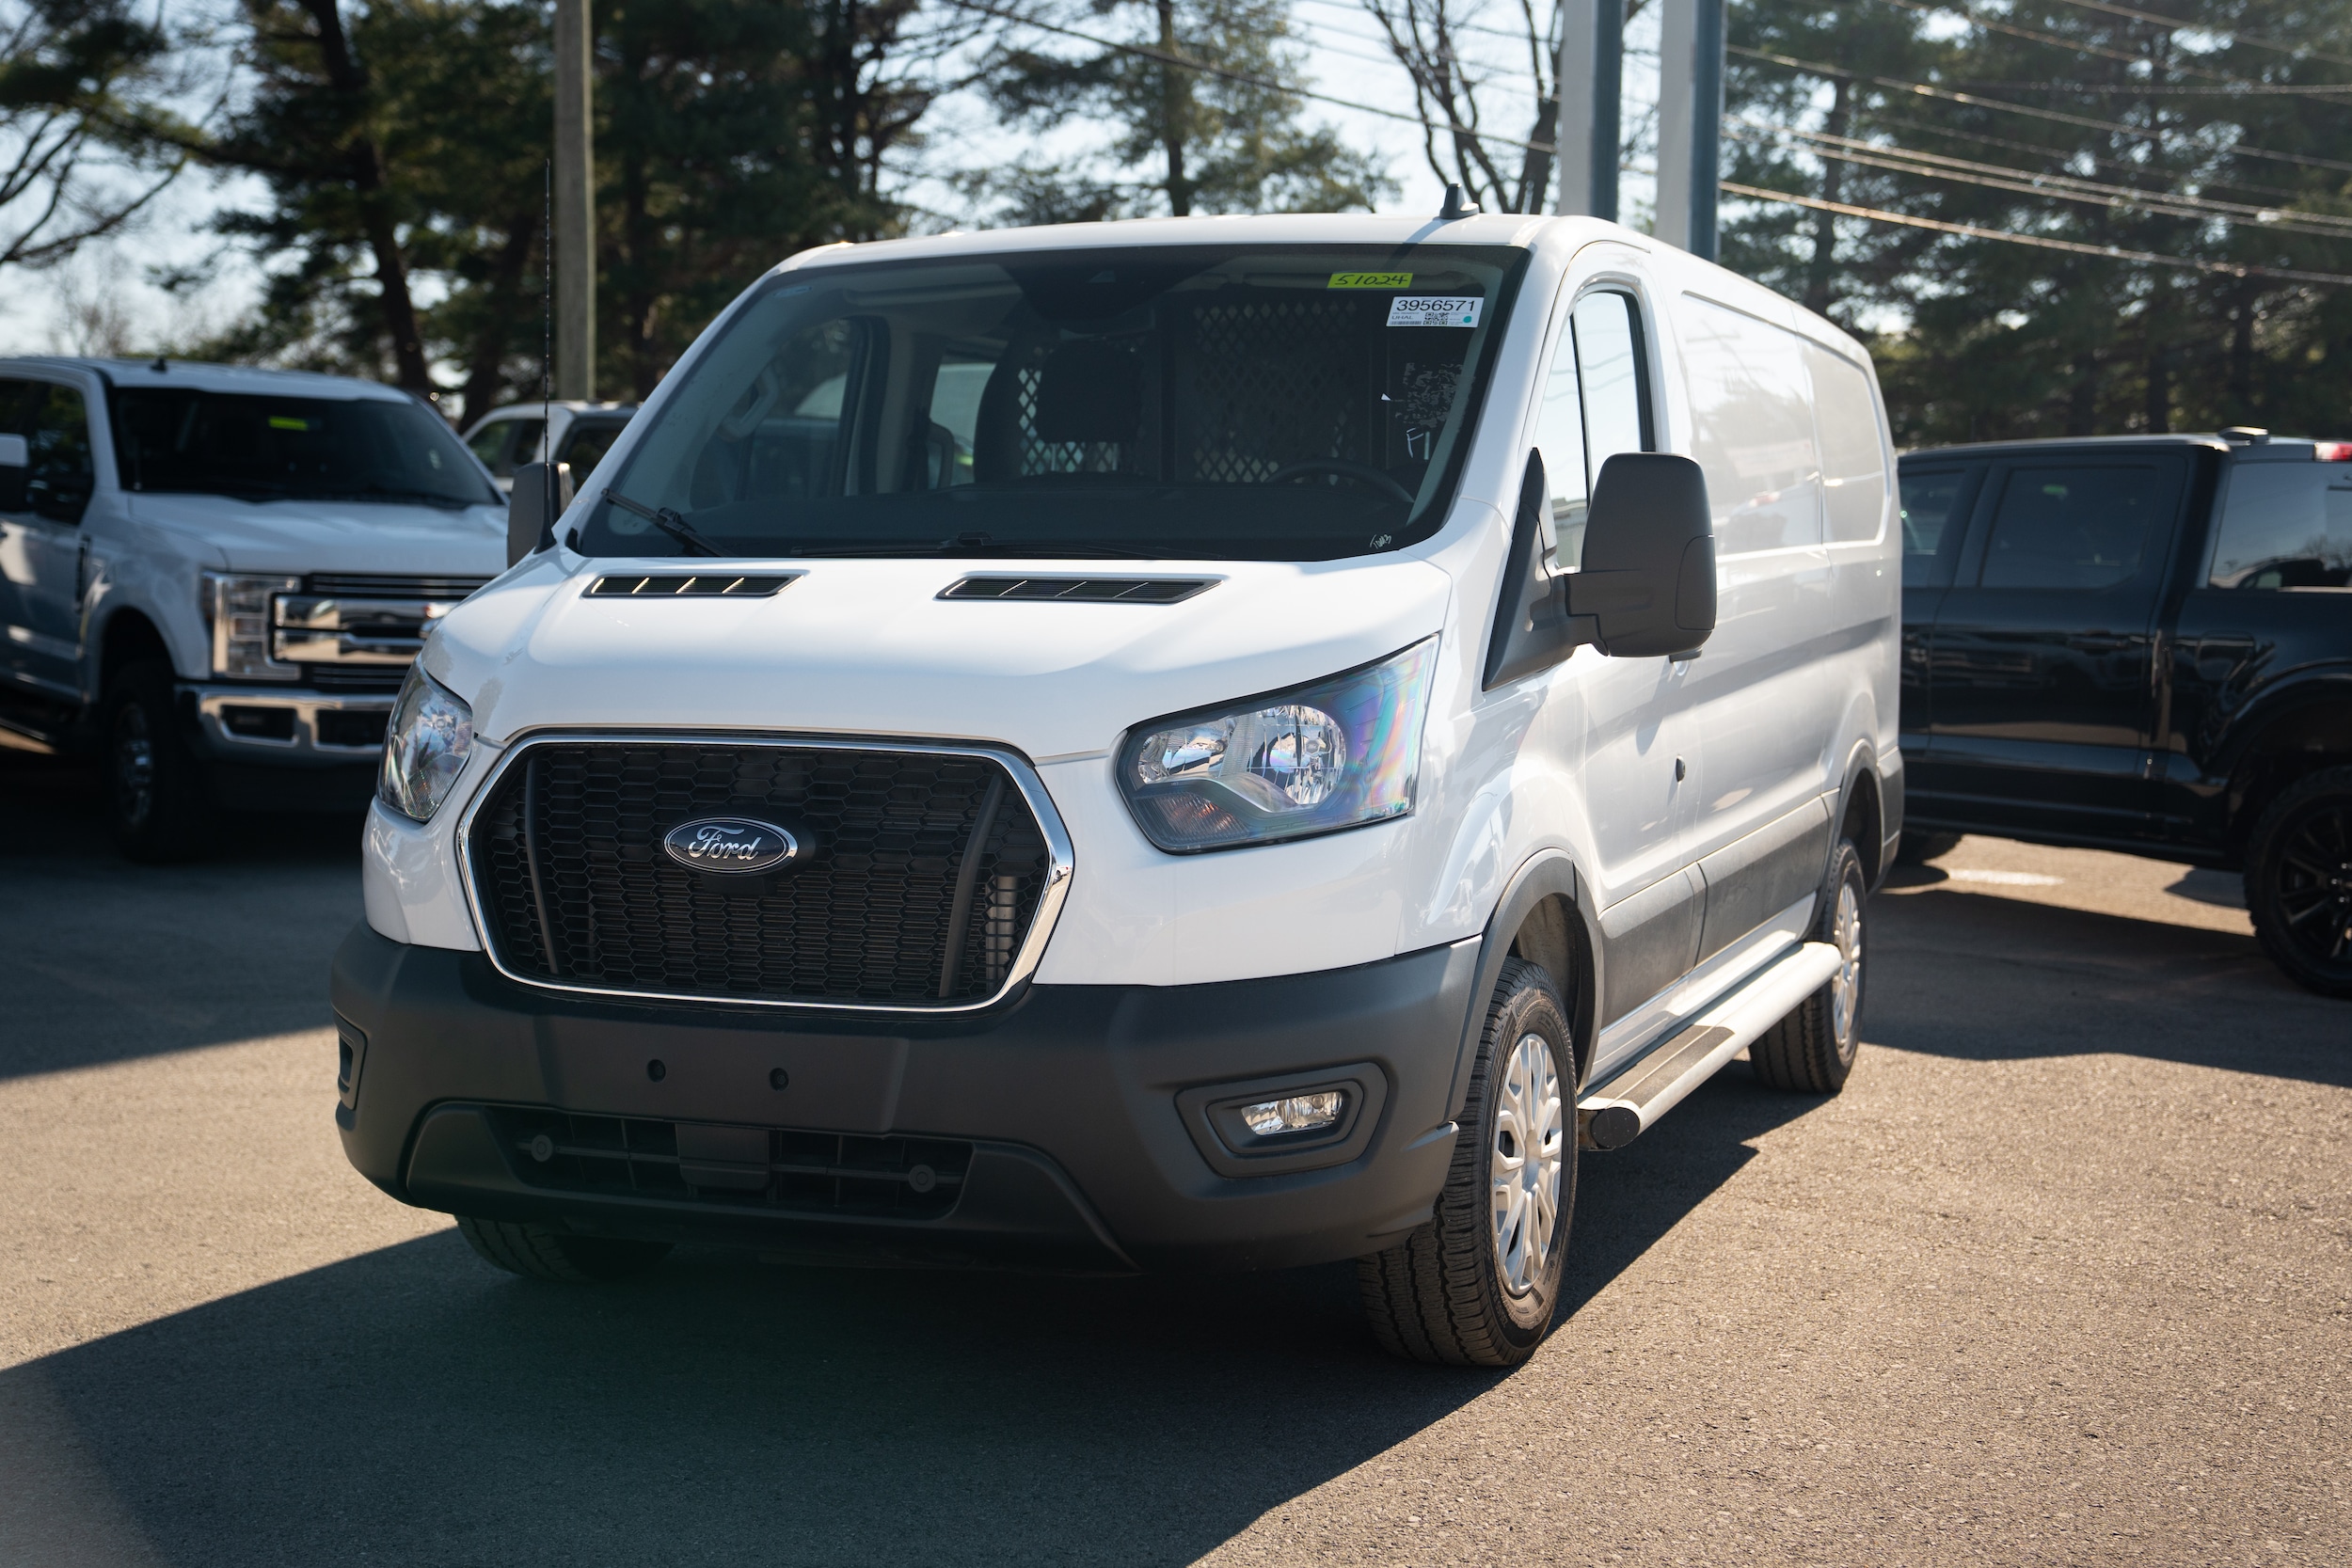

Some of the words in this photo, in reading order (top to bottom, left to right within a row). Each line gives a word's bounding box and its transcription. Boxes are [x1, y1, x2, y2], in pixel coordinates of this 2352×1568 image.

[1334, 275, 1408, 286] 51024
[1396, 299, 1475, 312] 3956571
[688, 825, 762, 861] Ford
